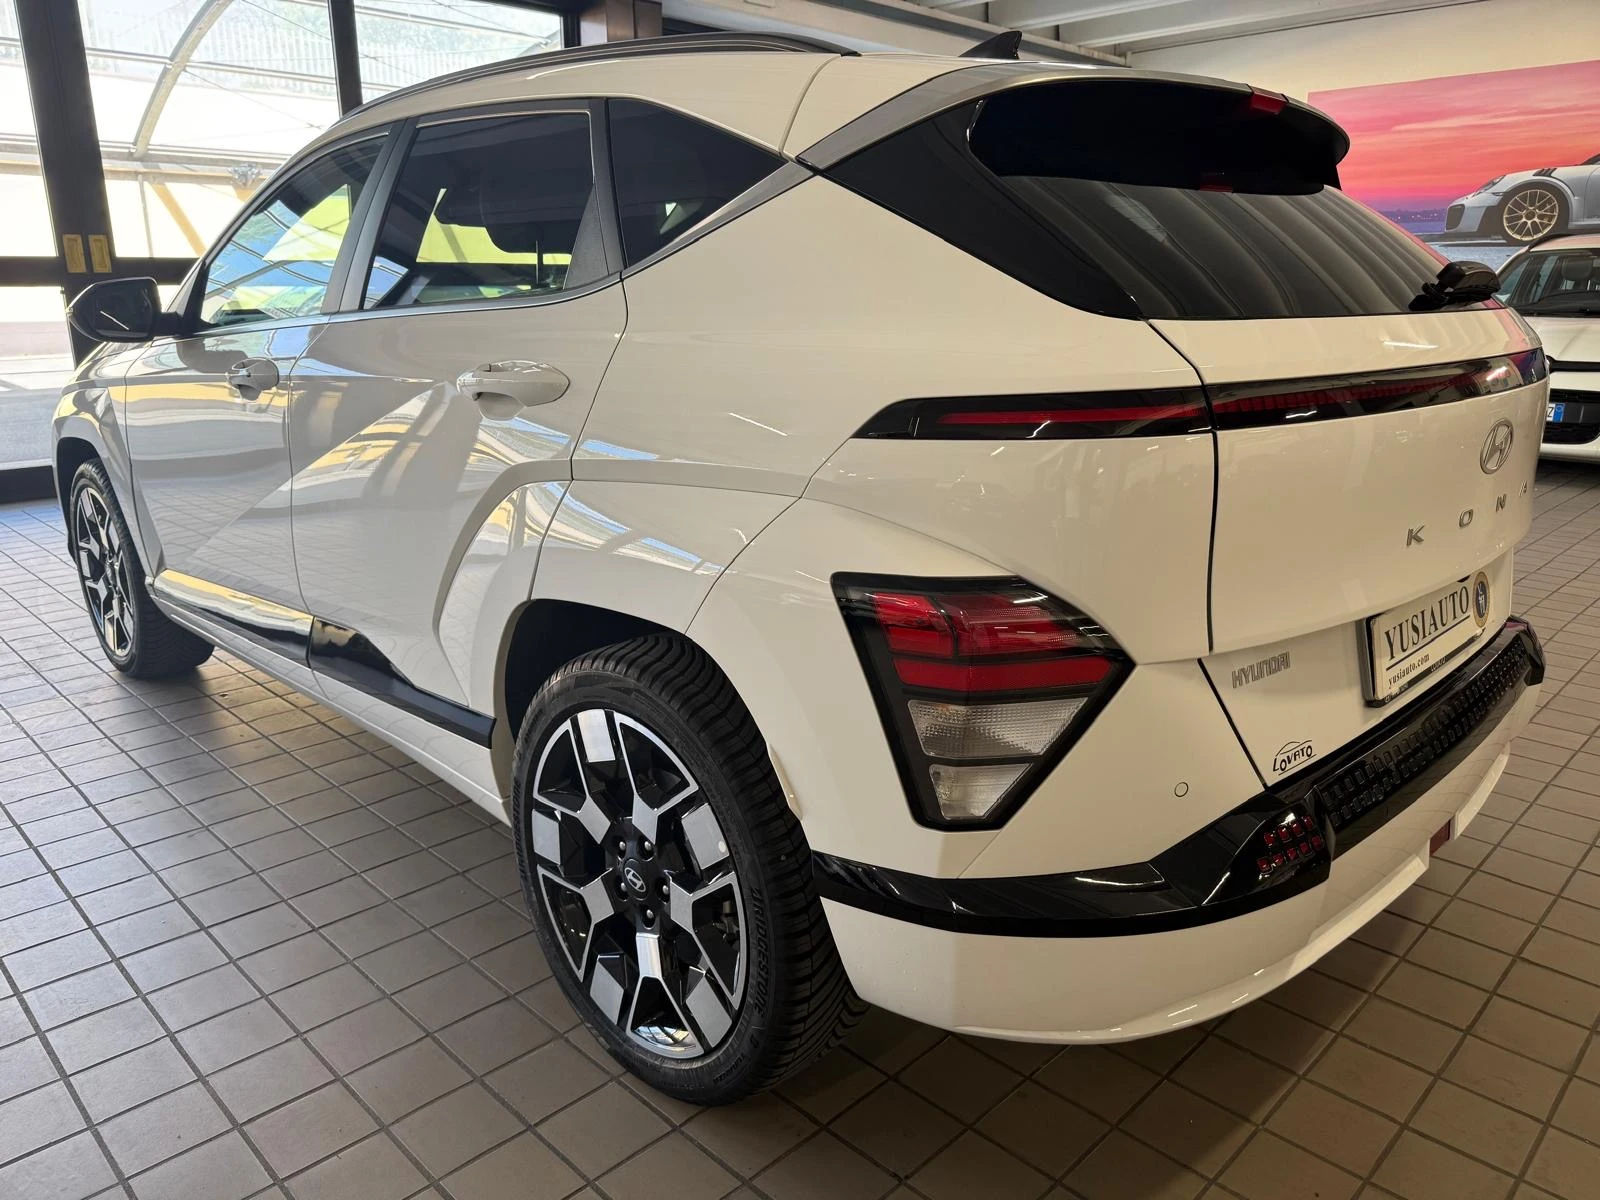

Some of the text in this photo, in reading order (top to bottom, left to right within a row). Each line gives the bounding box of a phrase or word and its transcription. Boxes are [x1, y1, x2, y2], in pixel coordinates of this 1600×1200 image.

[1385, 586, 1469, 660] YUSIAUTO
[1231, 651, 1290, 688] HYUNDAI
[1388, 653, 1430, 689] yusiauto.com
[1272, 745, 1312, 772] LOVATO
[751, 887, 770, 1017] BRIDGESTONE
